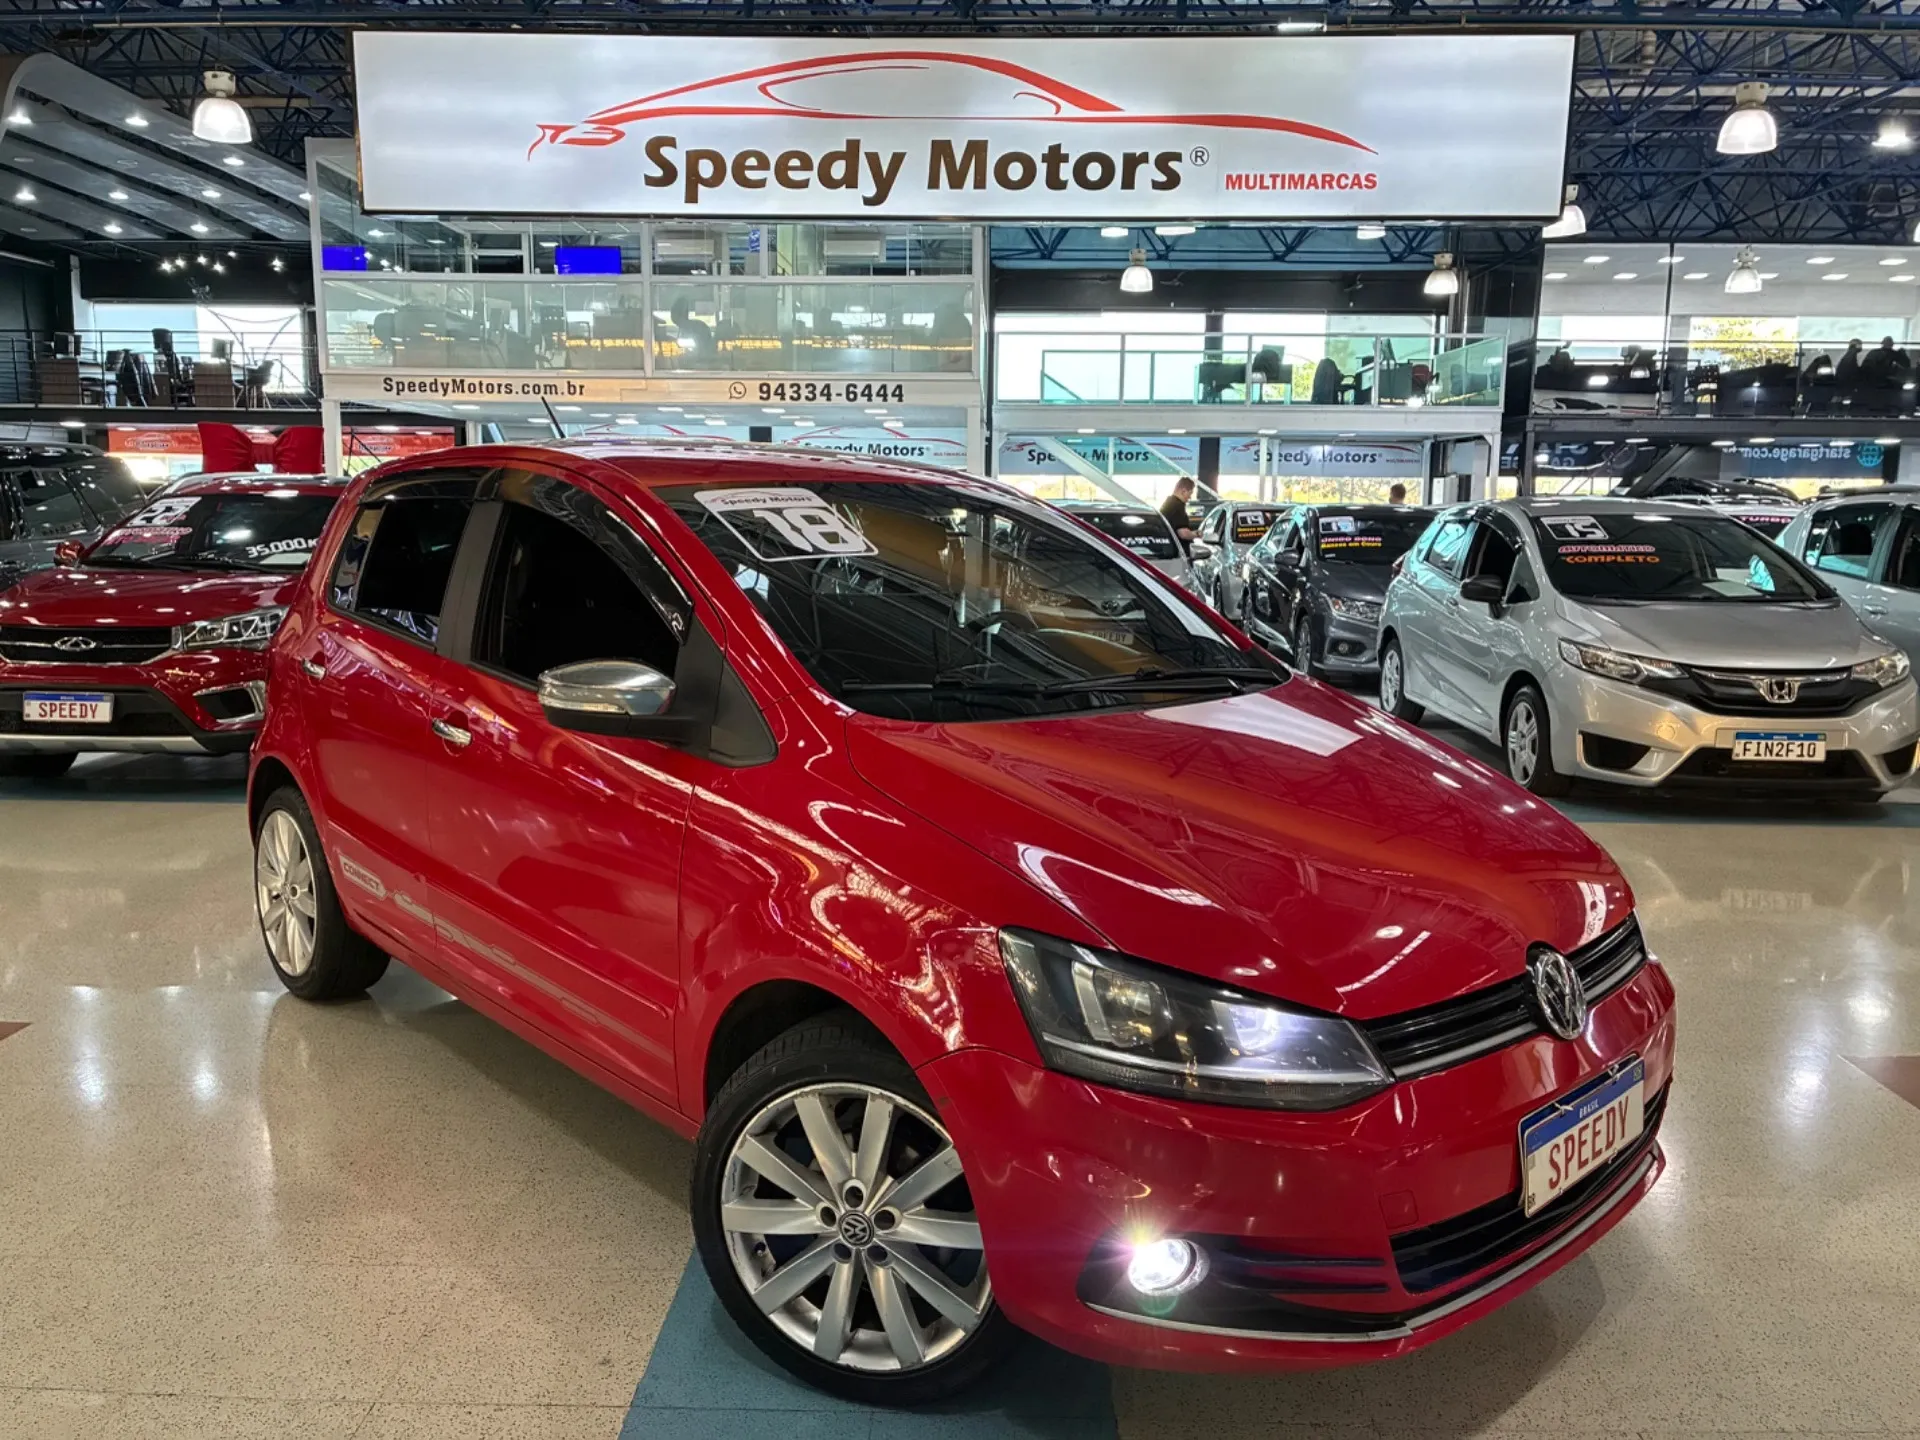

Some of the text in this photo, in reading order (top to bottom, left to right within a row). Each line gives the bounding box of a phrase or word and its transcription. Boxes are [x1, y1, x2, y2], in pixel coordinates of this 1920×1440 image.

[643, 135, 908, 207] Speedy
[927, 139, 1183, 191] Motors
[1225, 172, 1378, 190] MULTIMARCAS
[382, 376, 586, 397] SpeedyMotors.com.br
[758, 381, 905, 403] 94334-6444
[867, 442, 925, 457] Motors
[753, 508, 867, 553] 18
[1564, 520, 1605, 538] 15
[1565, 555, 1661, 563] COMPLETO
[38, 702, 98, 719] SPEEDY
[1742, 741, 1816, 758] FIN2F10
[1548, 1095, 1629, 1190] SPEEDY
